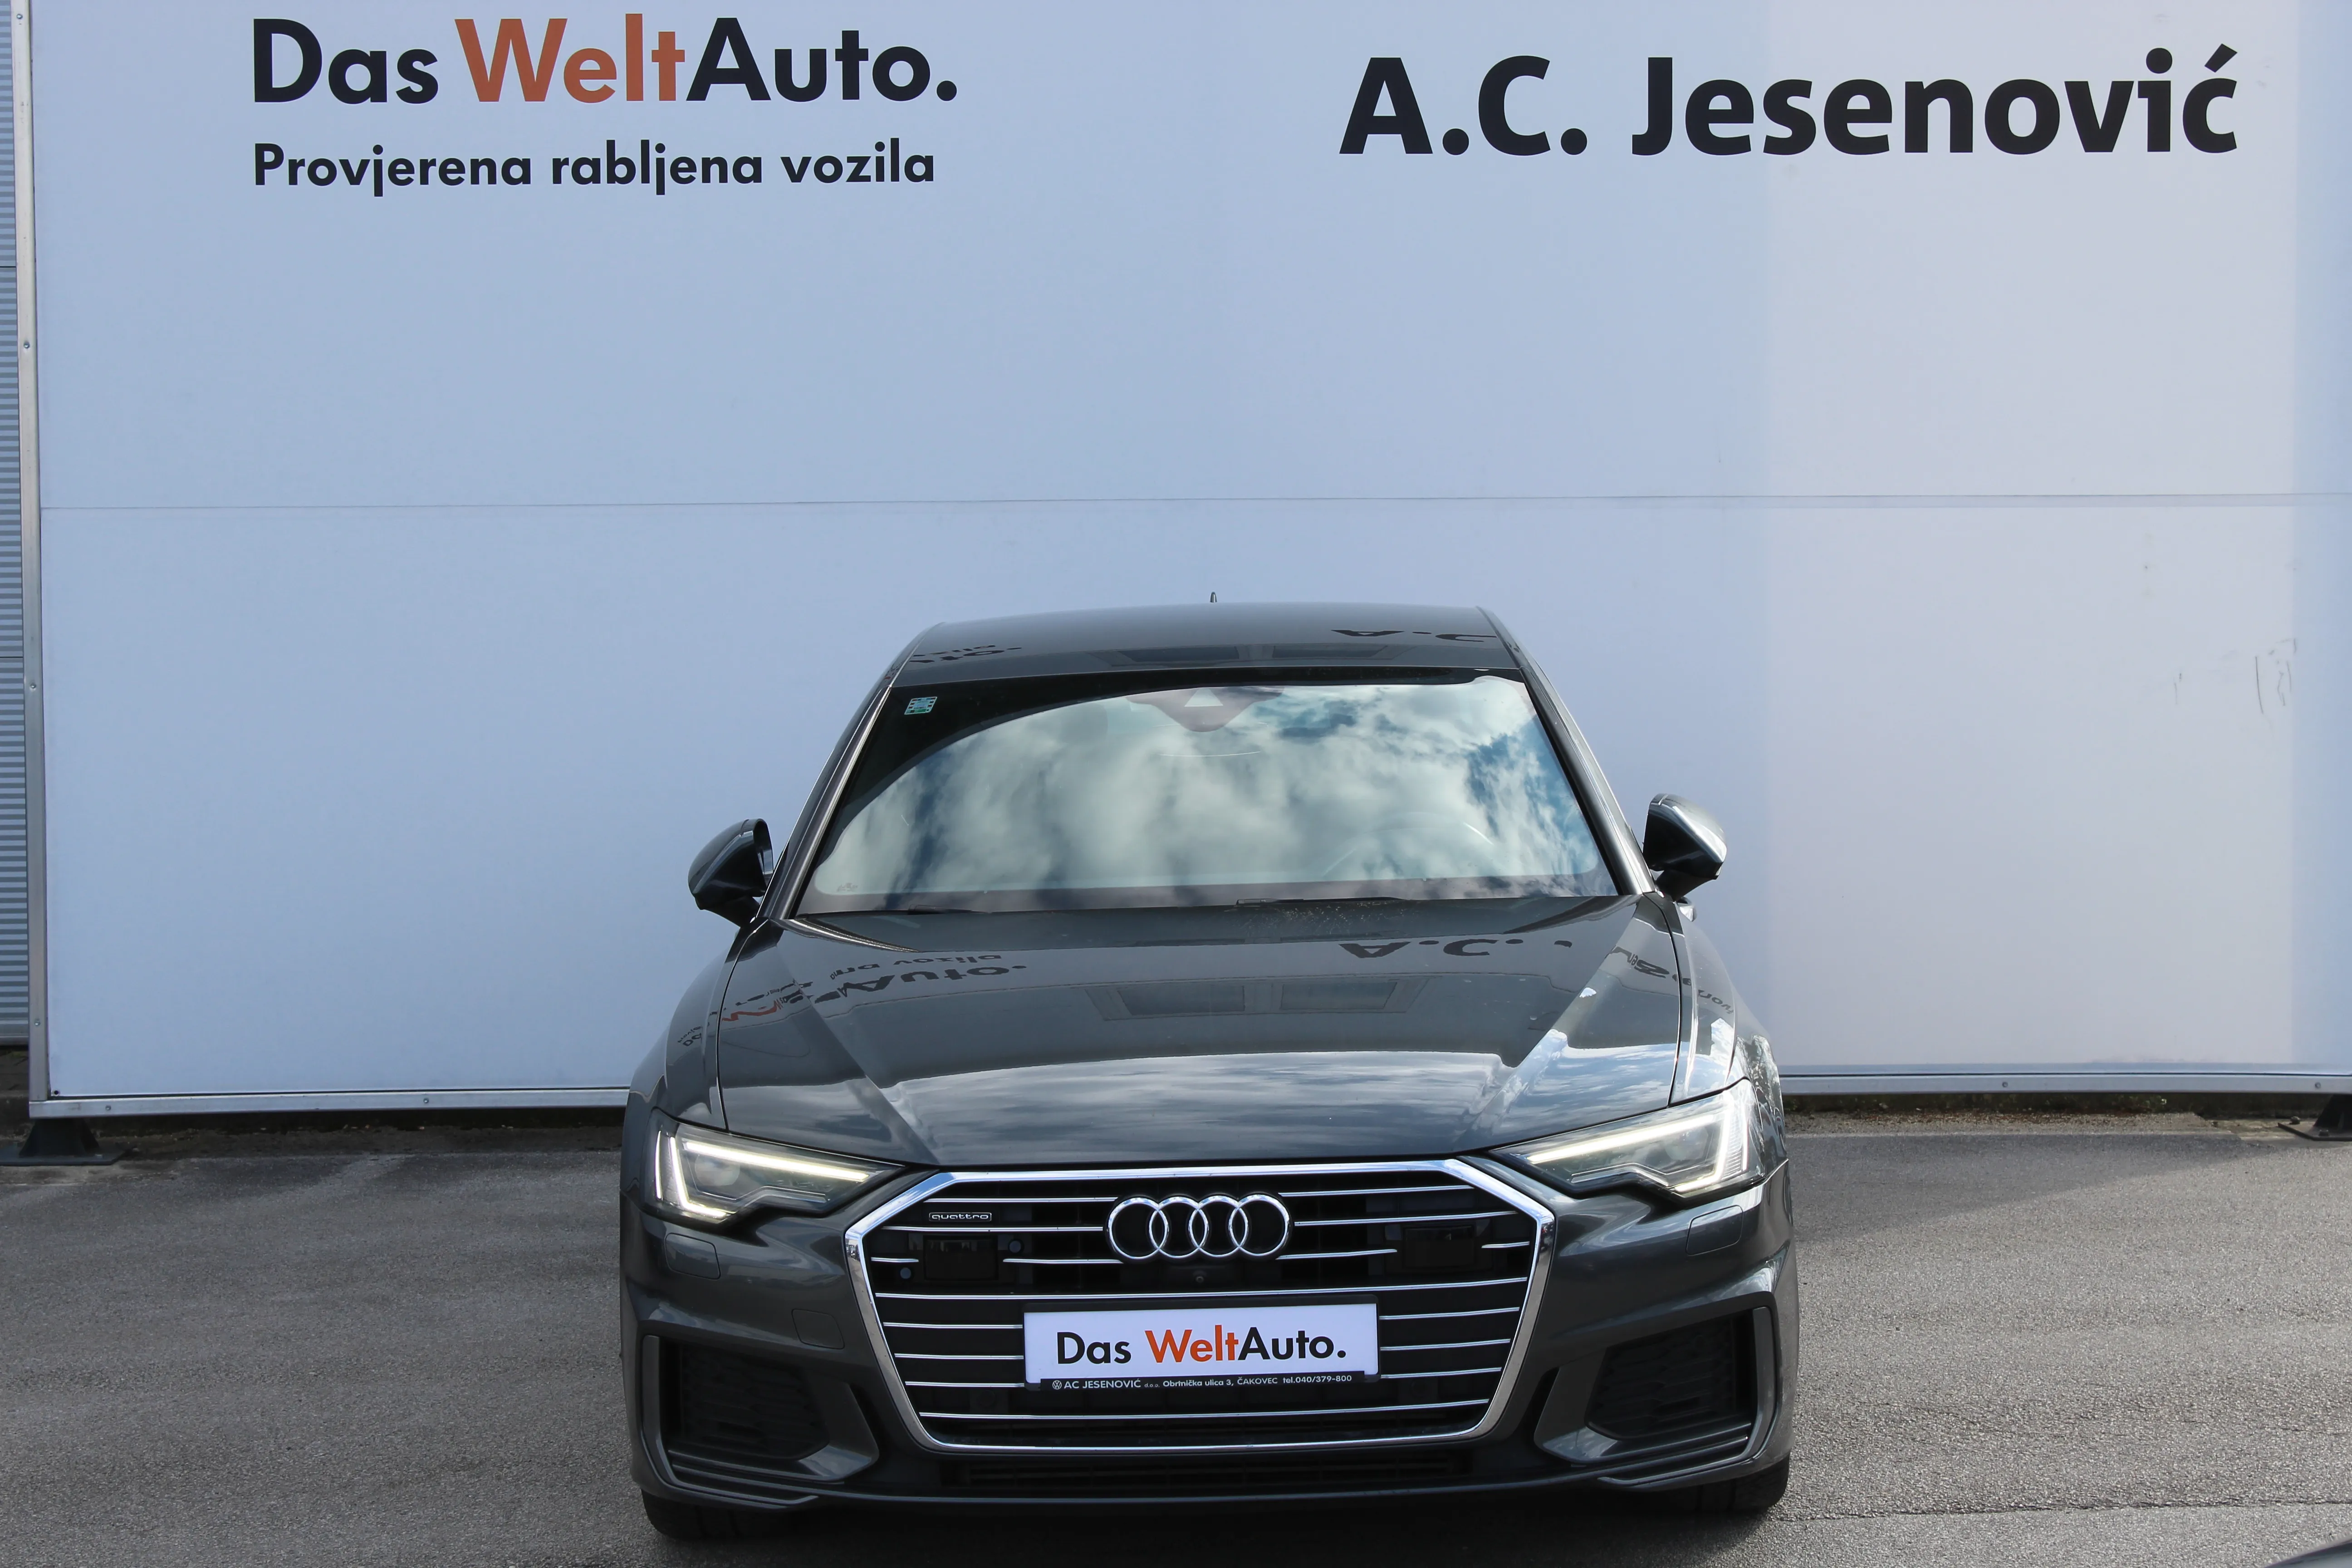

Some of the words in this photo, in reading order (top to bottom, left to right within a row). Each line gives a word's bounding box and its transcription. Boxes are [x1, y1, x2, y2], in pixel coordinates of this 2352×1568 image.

[254, 18, 438, 104] Das
[455, 13, 957, 103] WeltAuto.
[1339, 55, 1588, 156] A.C.
[1632, 44, 2238, 156] Jesenović
[255, 143, 531, 197] Provjerena
[552, 139, 762, 196] rabljena
[781, 137, 934, 183] vozila
[1057, 1332, 1132, 1364] Das
[1144, 1324, 1346, 1363] WeltAuto.
[1082, 1378, 1141, 1389] JESENOVIĆ
[1237, 1377, 1278, 1385] ČAKOVEC
[1283, 1375, 1352, 1384] tel.040/379-800
